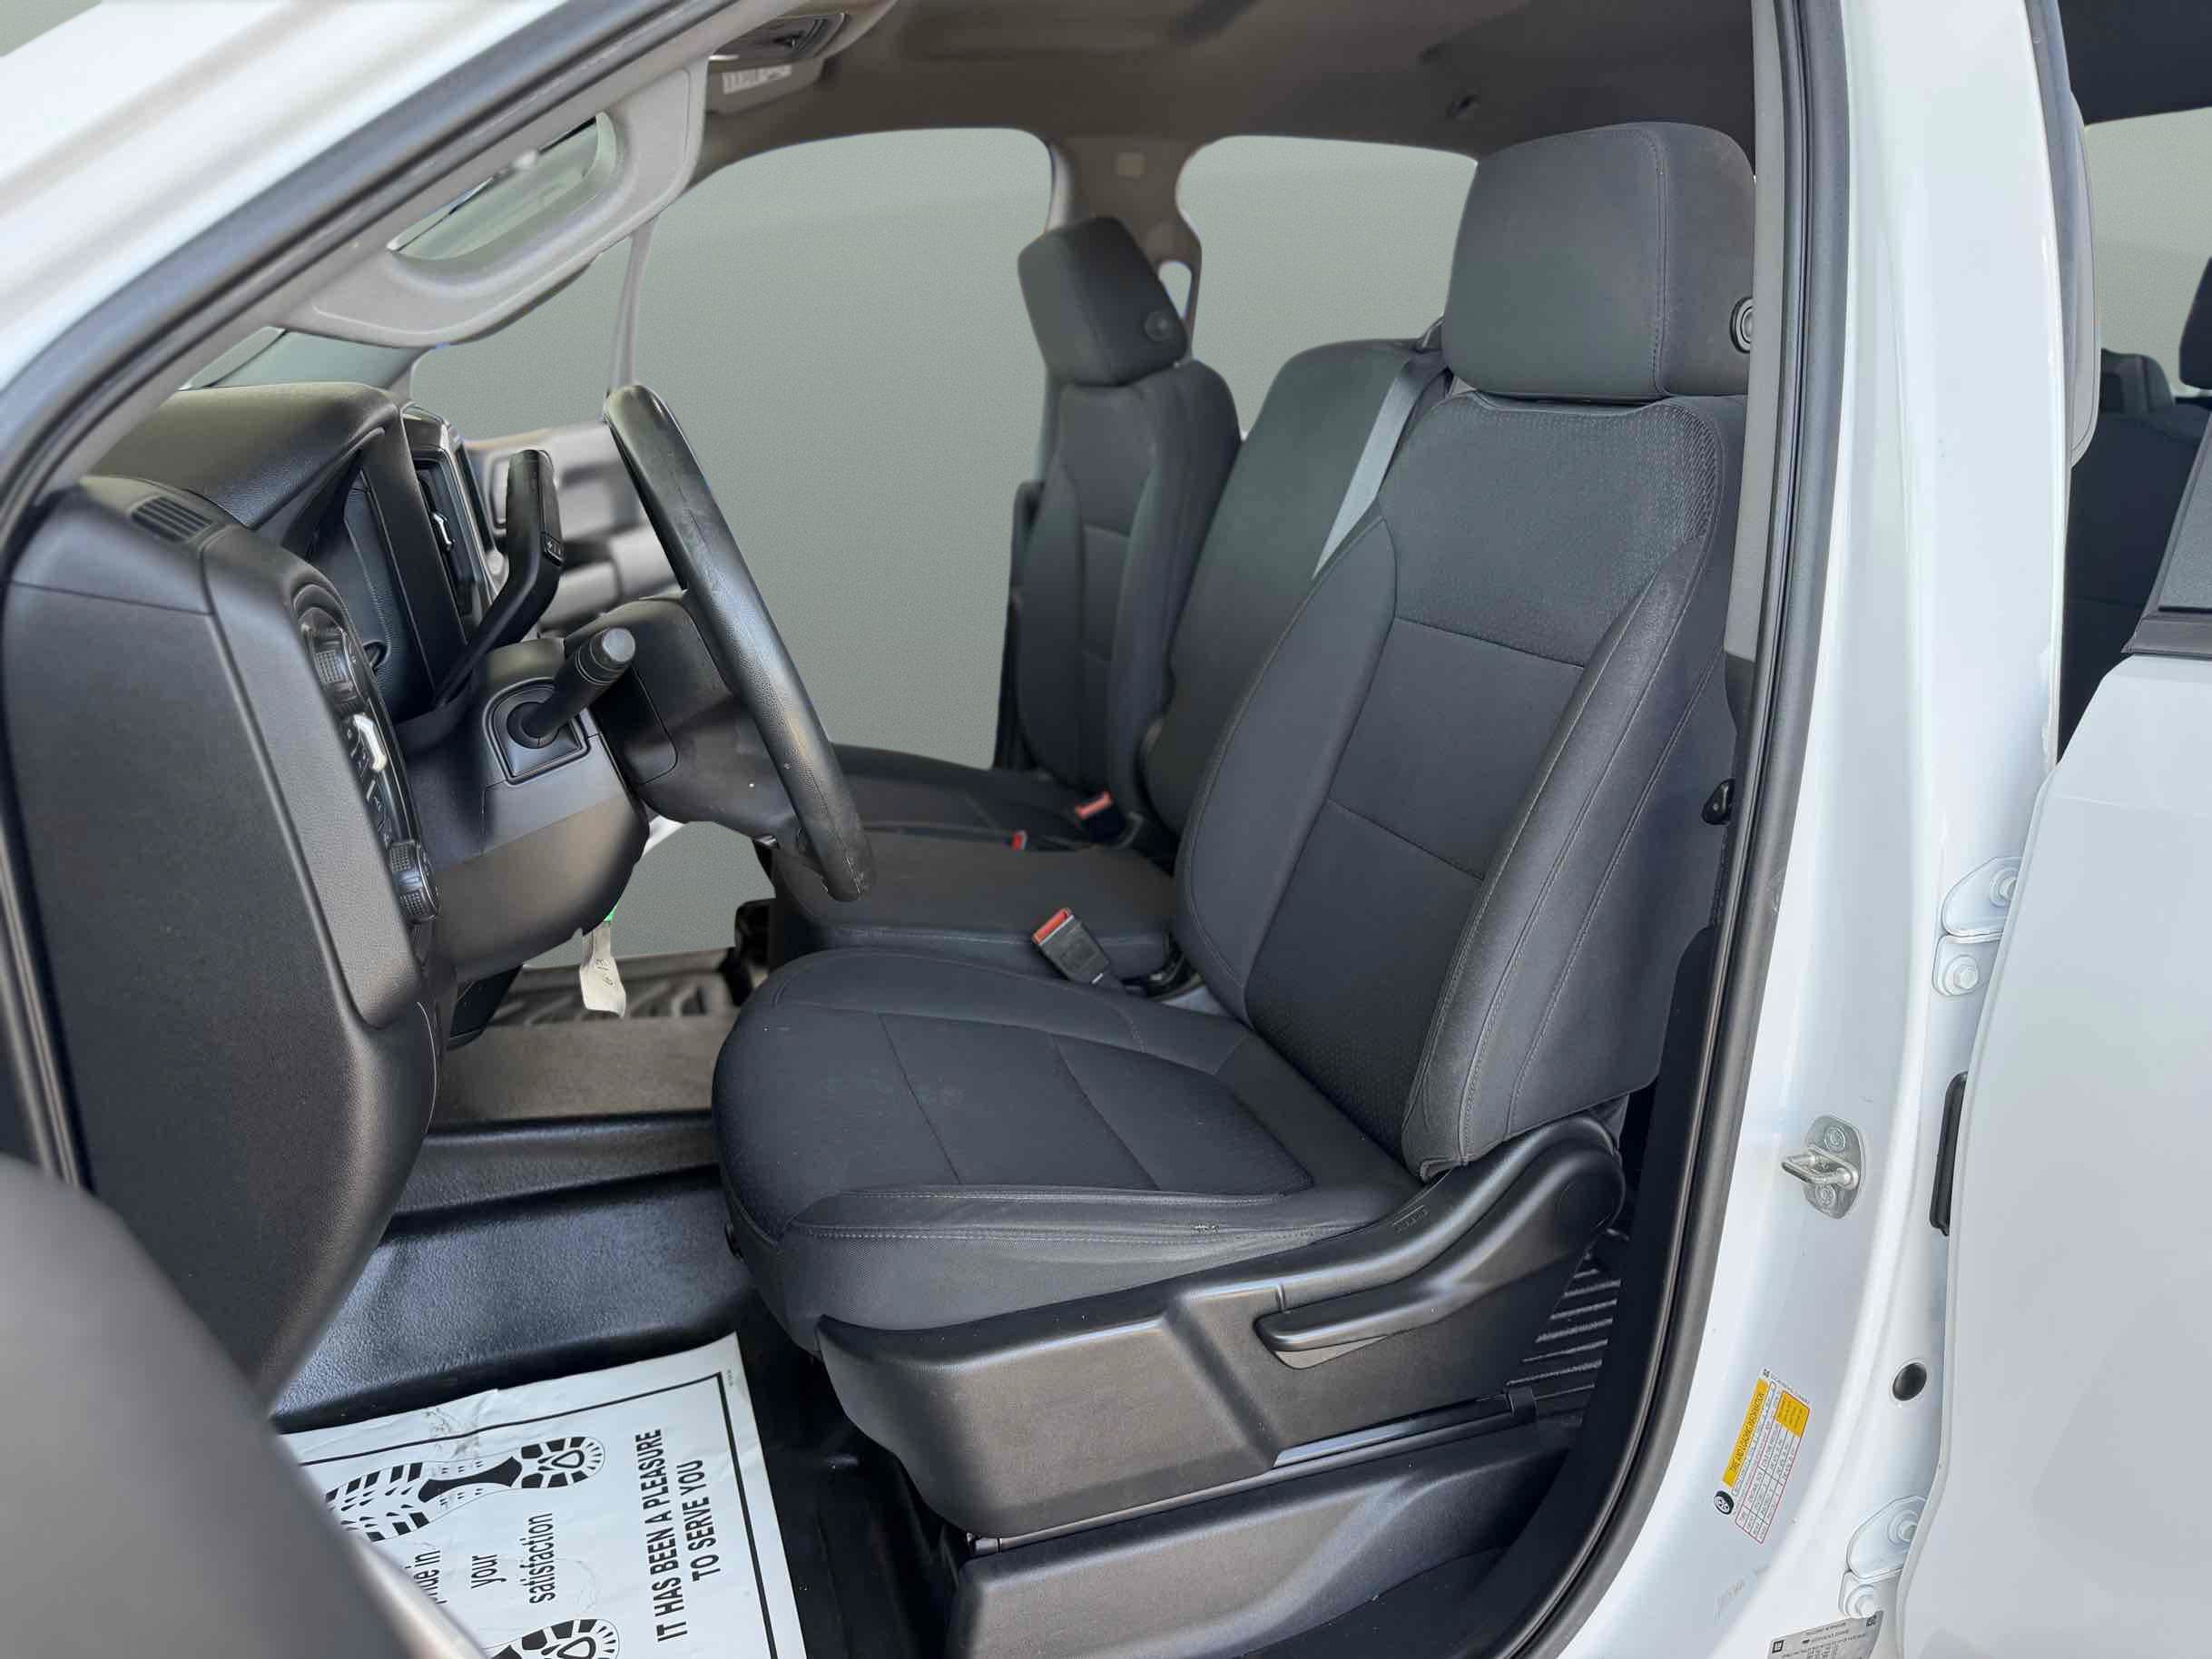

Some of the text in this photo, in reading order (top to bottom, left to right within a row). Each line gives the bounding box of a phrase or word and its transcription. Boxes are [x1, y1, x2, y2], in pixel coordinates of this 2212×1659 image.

[405, 1549, 441, 1569] in
[519, 1513, 555, 1605] satisfaction
[635, 1428, 688, 1642] IT HAS BEEN A PLEASURE
[675, 1459, 721, 1582] TO SERVE YOU
[470, 1554, 507, 1589] your
